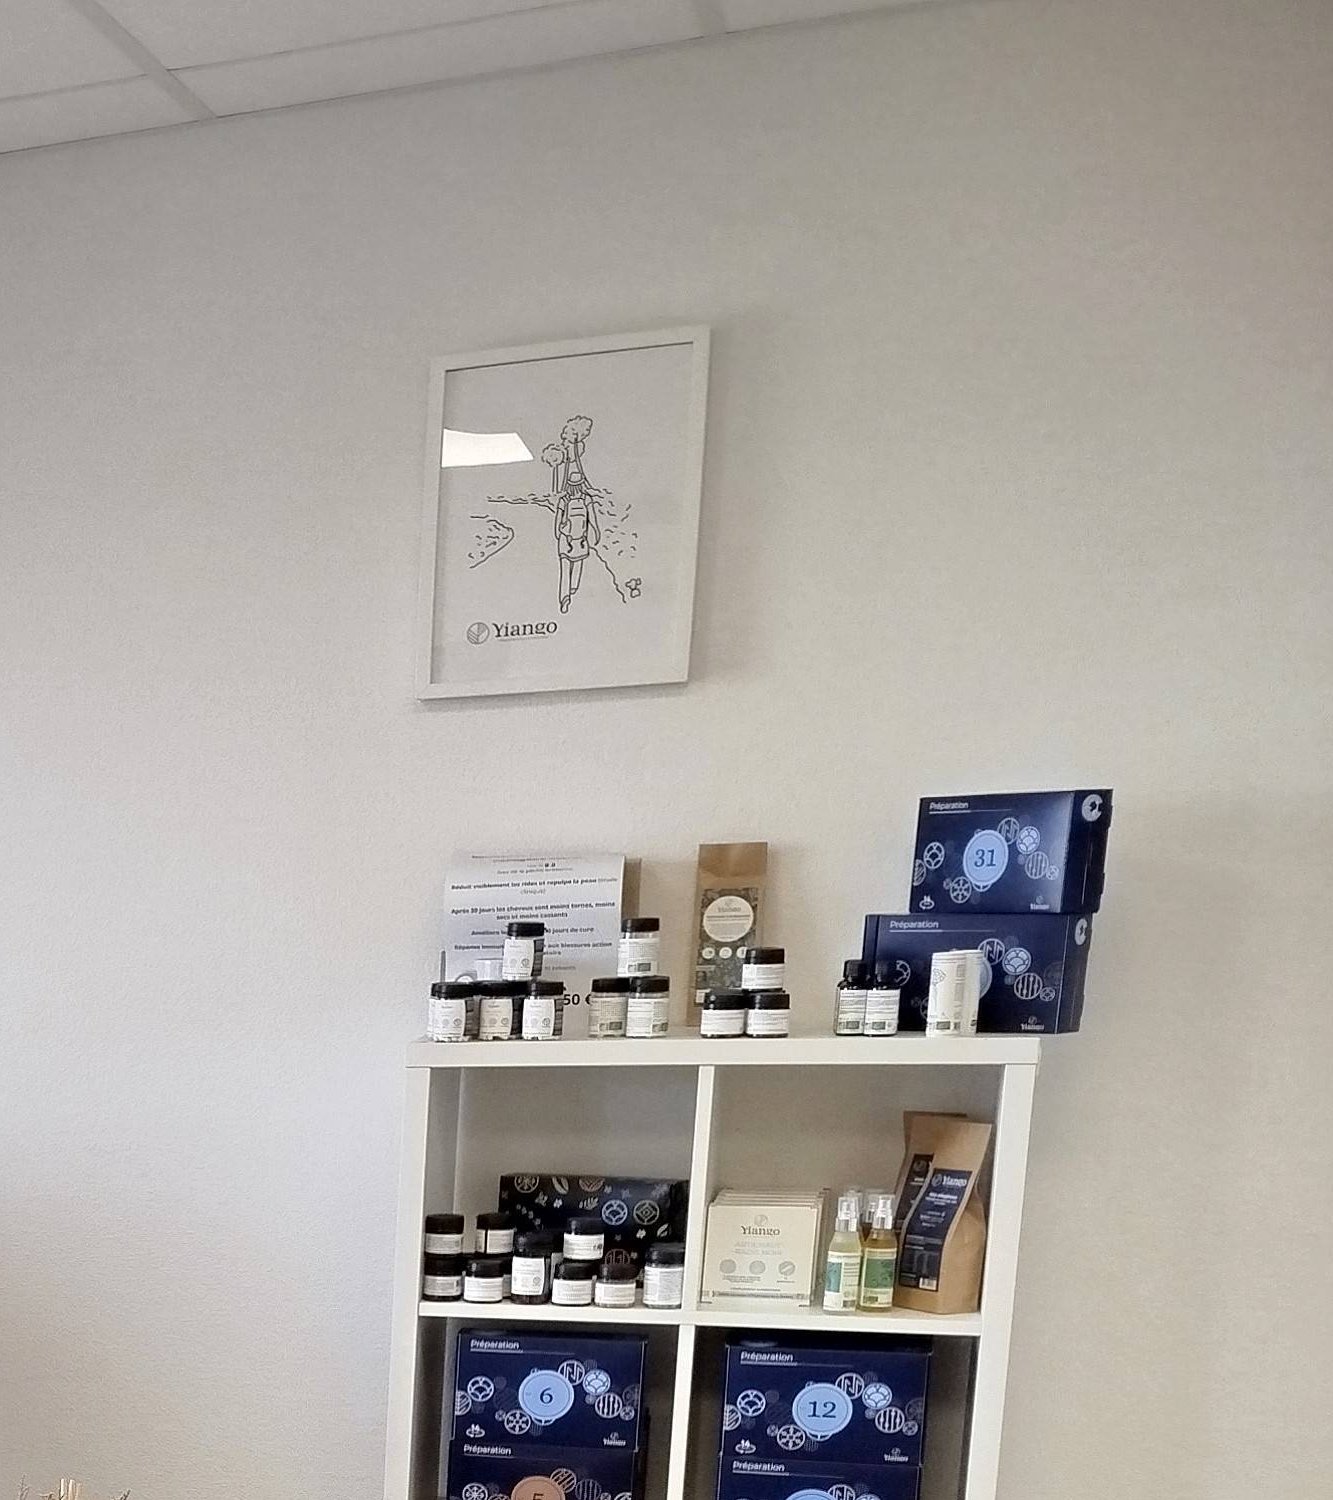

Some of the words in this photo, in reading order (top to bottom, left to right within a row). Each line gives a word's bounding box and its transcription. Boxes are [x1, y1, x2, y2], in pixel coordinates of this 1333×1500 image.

[492, 622, 558, 638] Yiango
[974, 848, 997, 868] 31
[890, 920, 939, 931] Préparation
[539, 1387, 553, 1405] 6
[806, 1399, 837, 1419] 12
